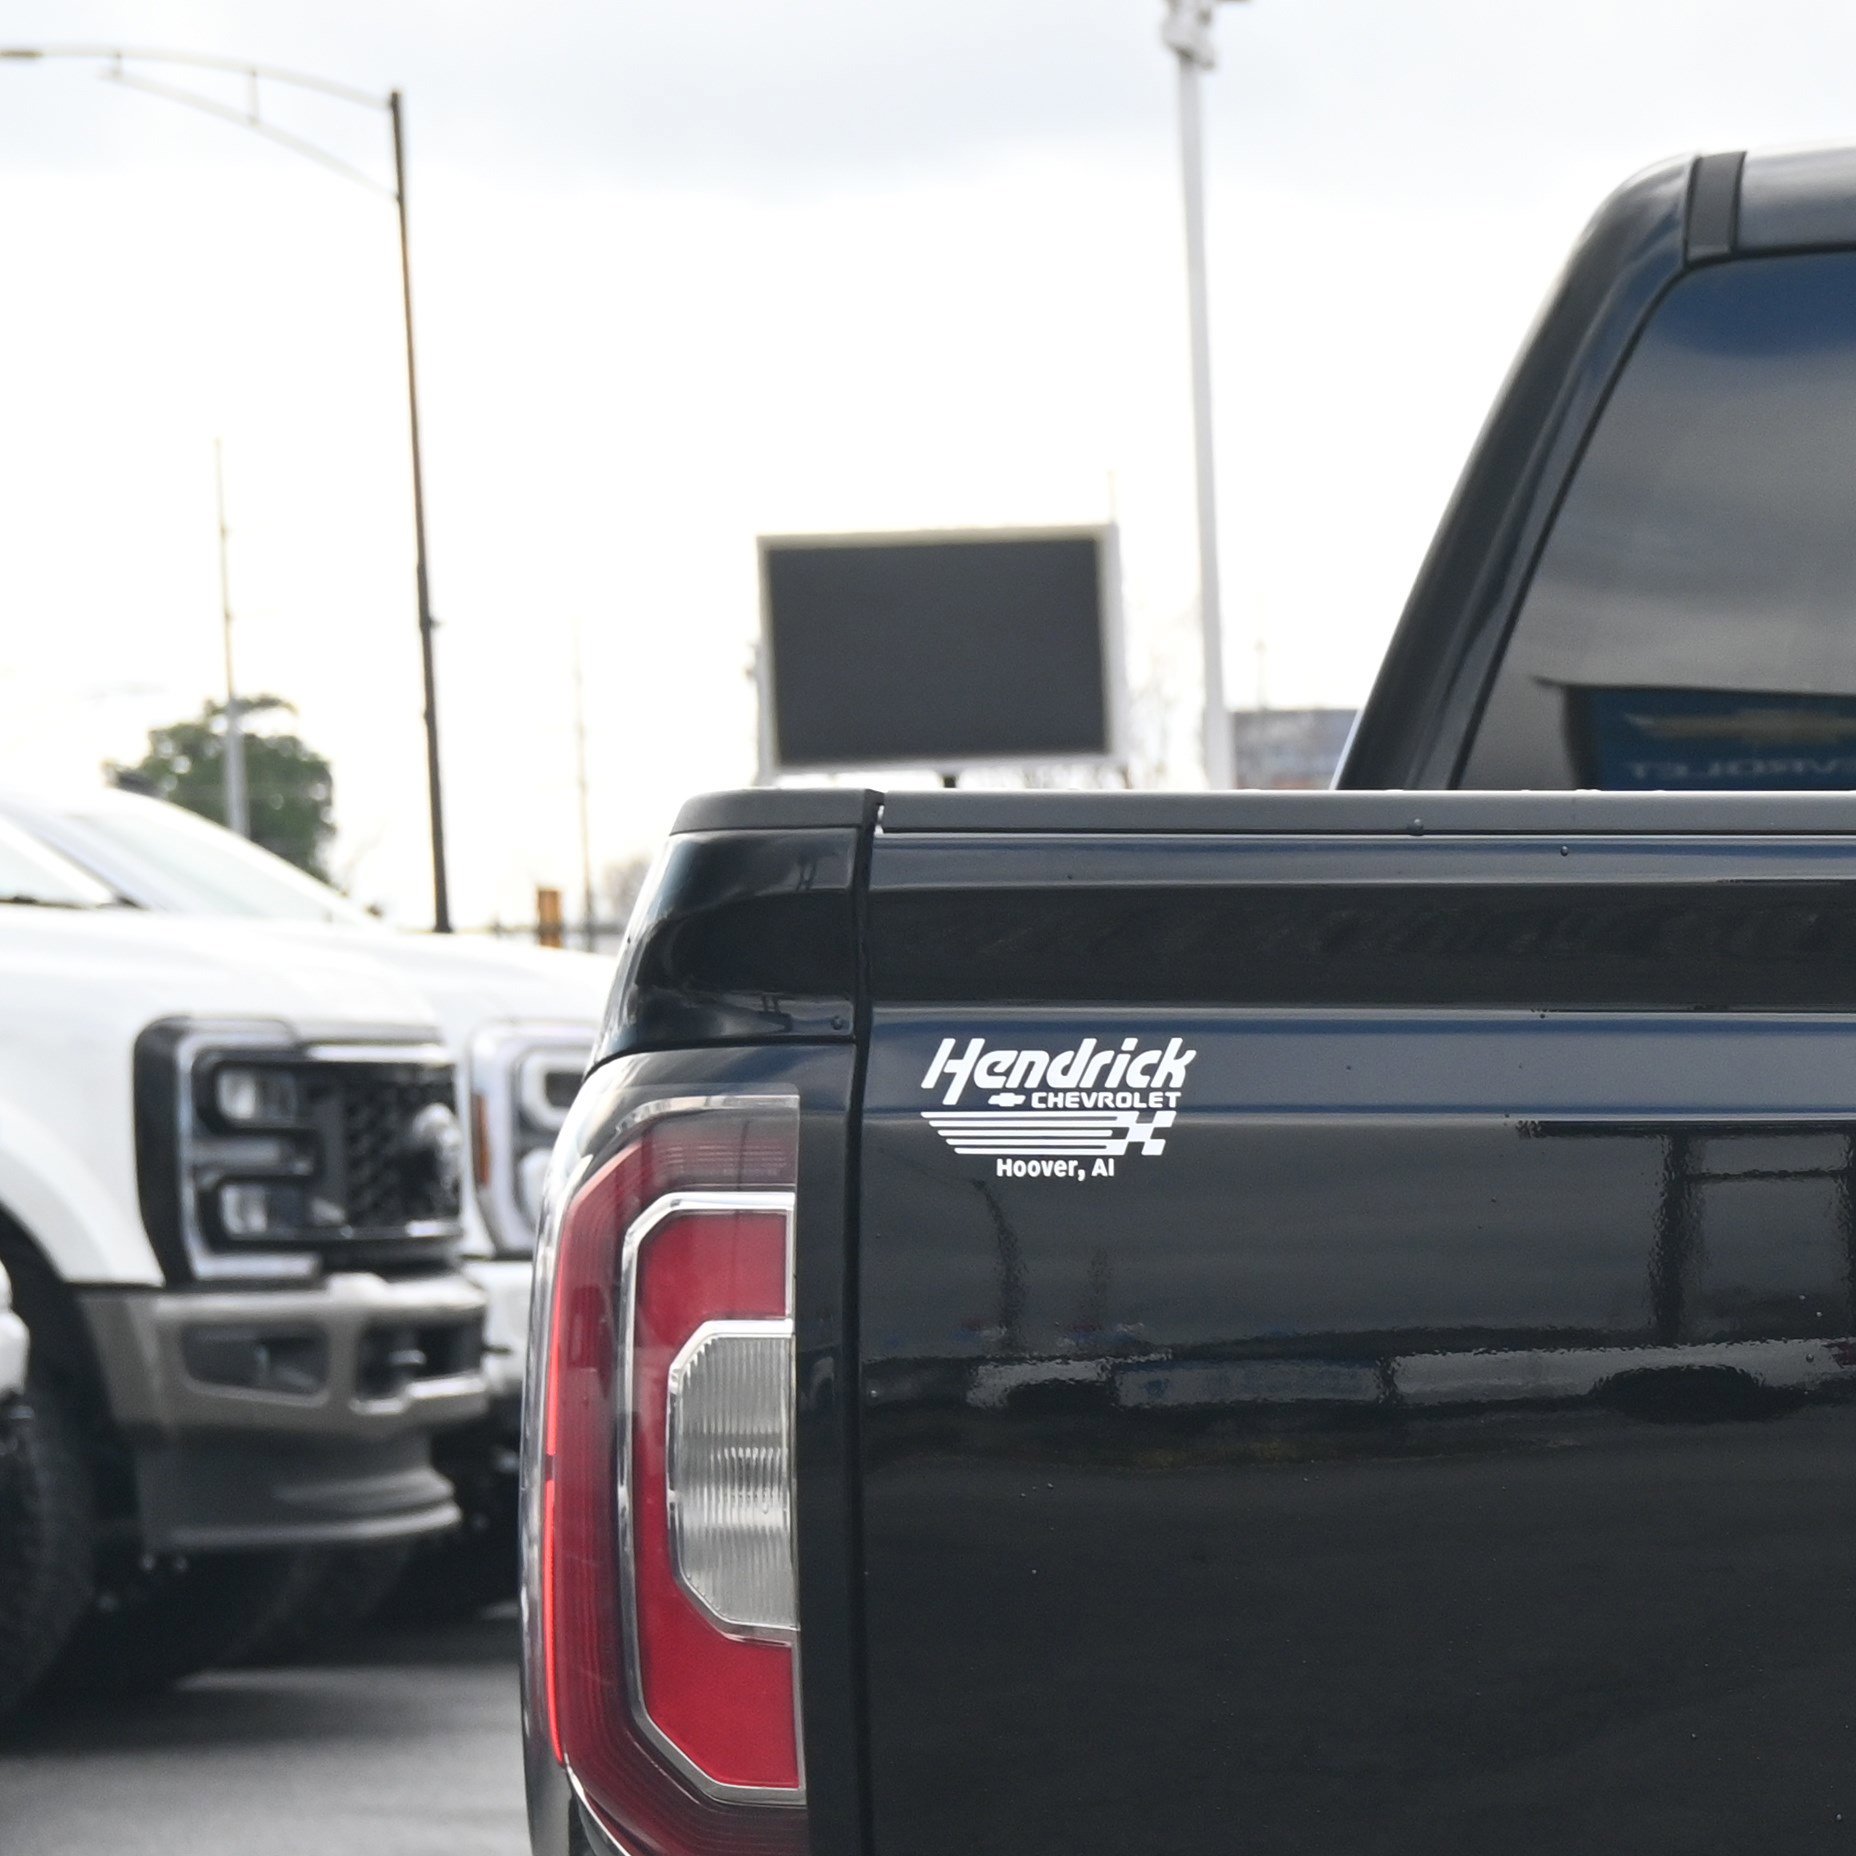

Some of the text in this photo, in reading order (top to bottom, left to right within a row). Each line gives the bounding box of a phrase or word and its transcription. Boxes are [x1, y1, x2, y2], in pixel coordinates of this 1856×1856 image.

[920, 1037, 1197, 1105] Hendrick
[1031, 1091, 1182, 1109] CHEVROLET
[996, 1158, 1086, 1181] Hoover,
